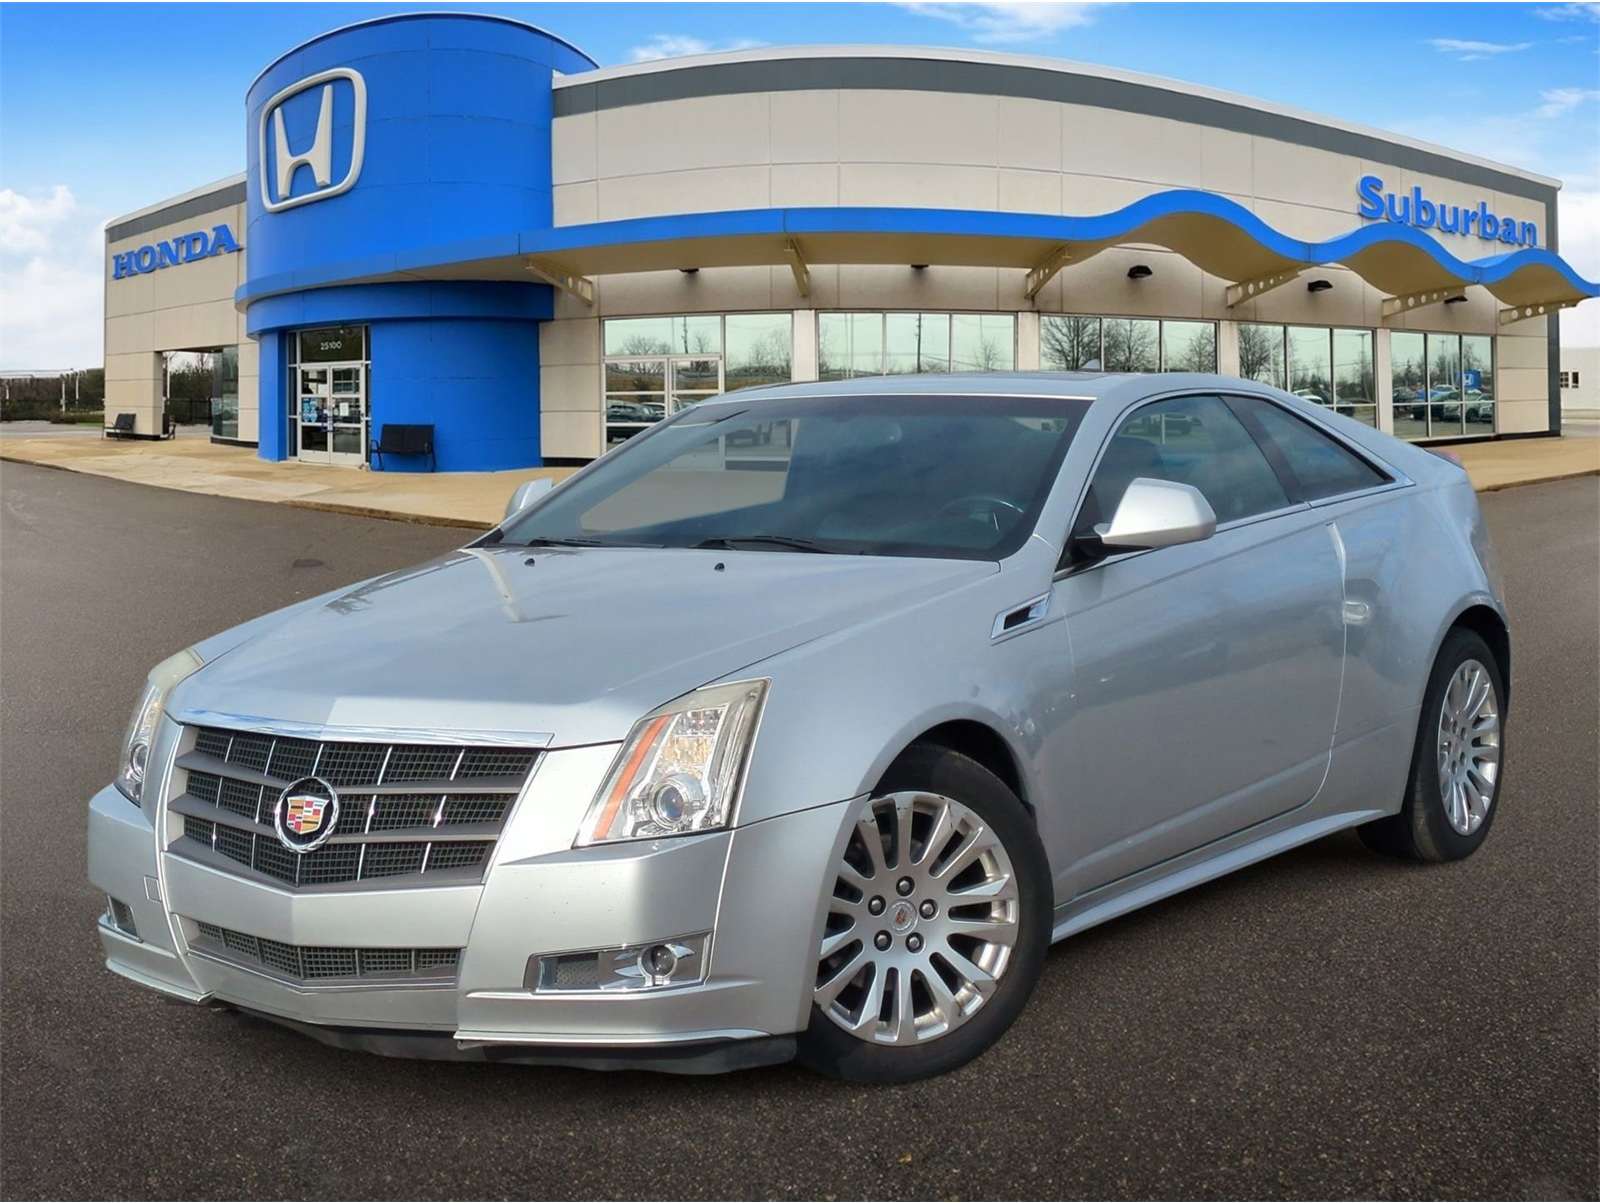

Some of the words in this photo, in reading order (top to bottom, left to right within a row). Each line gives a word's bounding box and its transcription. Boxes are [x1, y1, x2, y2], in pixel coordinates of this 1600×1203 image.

[1357, 175, 1538, 246] Suburban
[112, 224, 239, 279] HONDA
[320, 340, 342, 351] 25100
